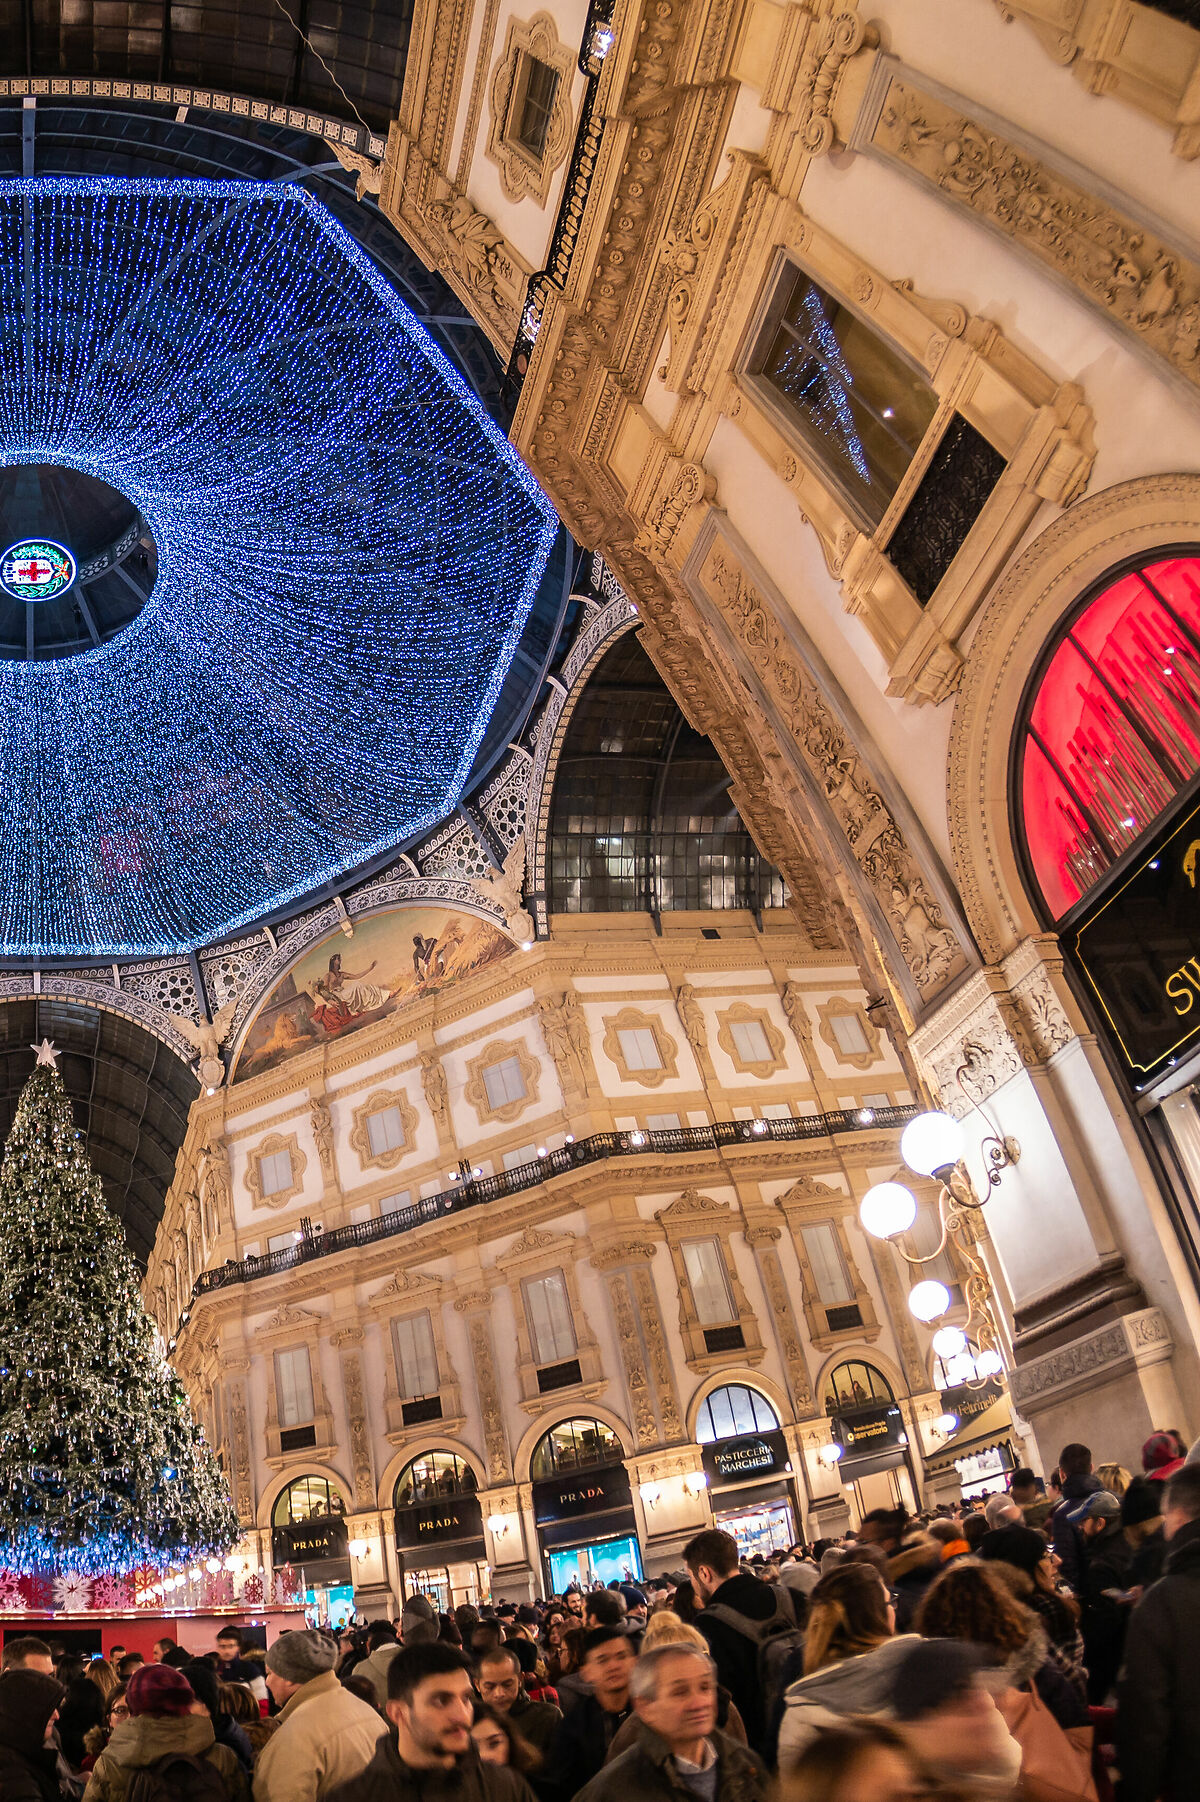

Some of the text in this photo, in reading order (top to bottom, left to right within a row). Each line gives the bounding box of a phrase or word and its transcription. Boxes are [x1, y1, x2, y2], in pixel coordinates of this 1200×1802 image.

[714, 1444, 775, 1465] PASTICCERIA
[721, 1454, 772, 1474] MARCHESI
[560, 1487, 604, 1504] PRADA
[419, 1516, 460, 1532] PRADA
[293, 1538, 329, 1551] PRADA
